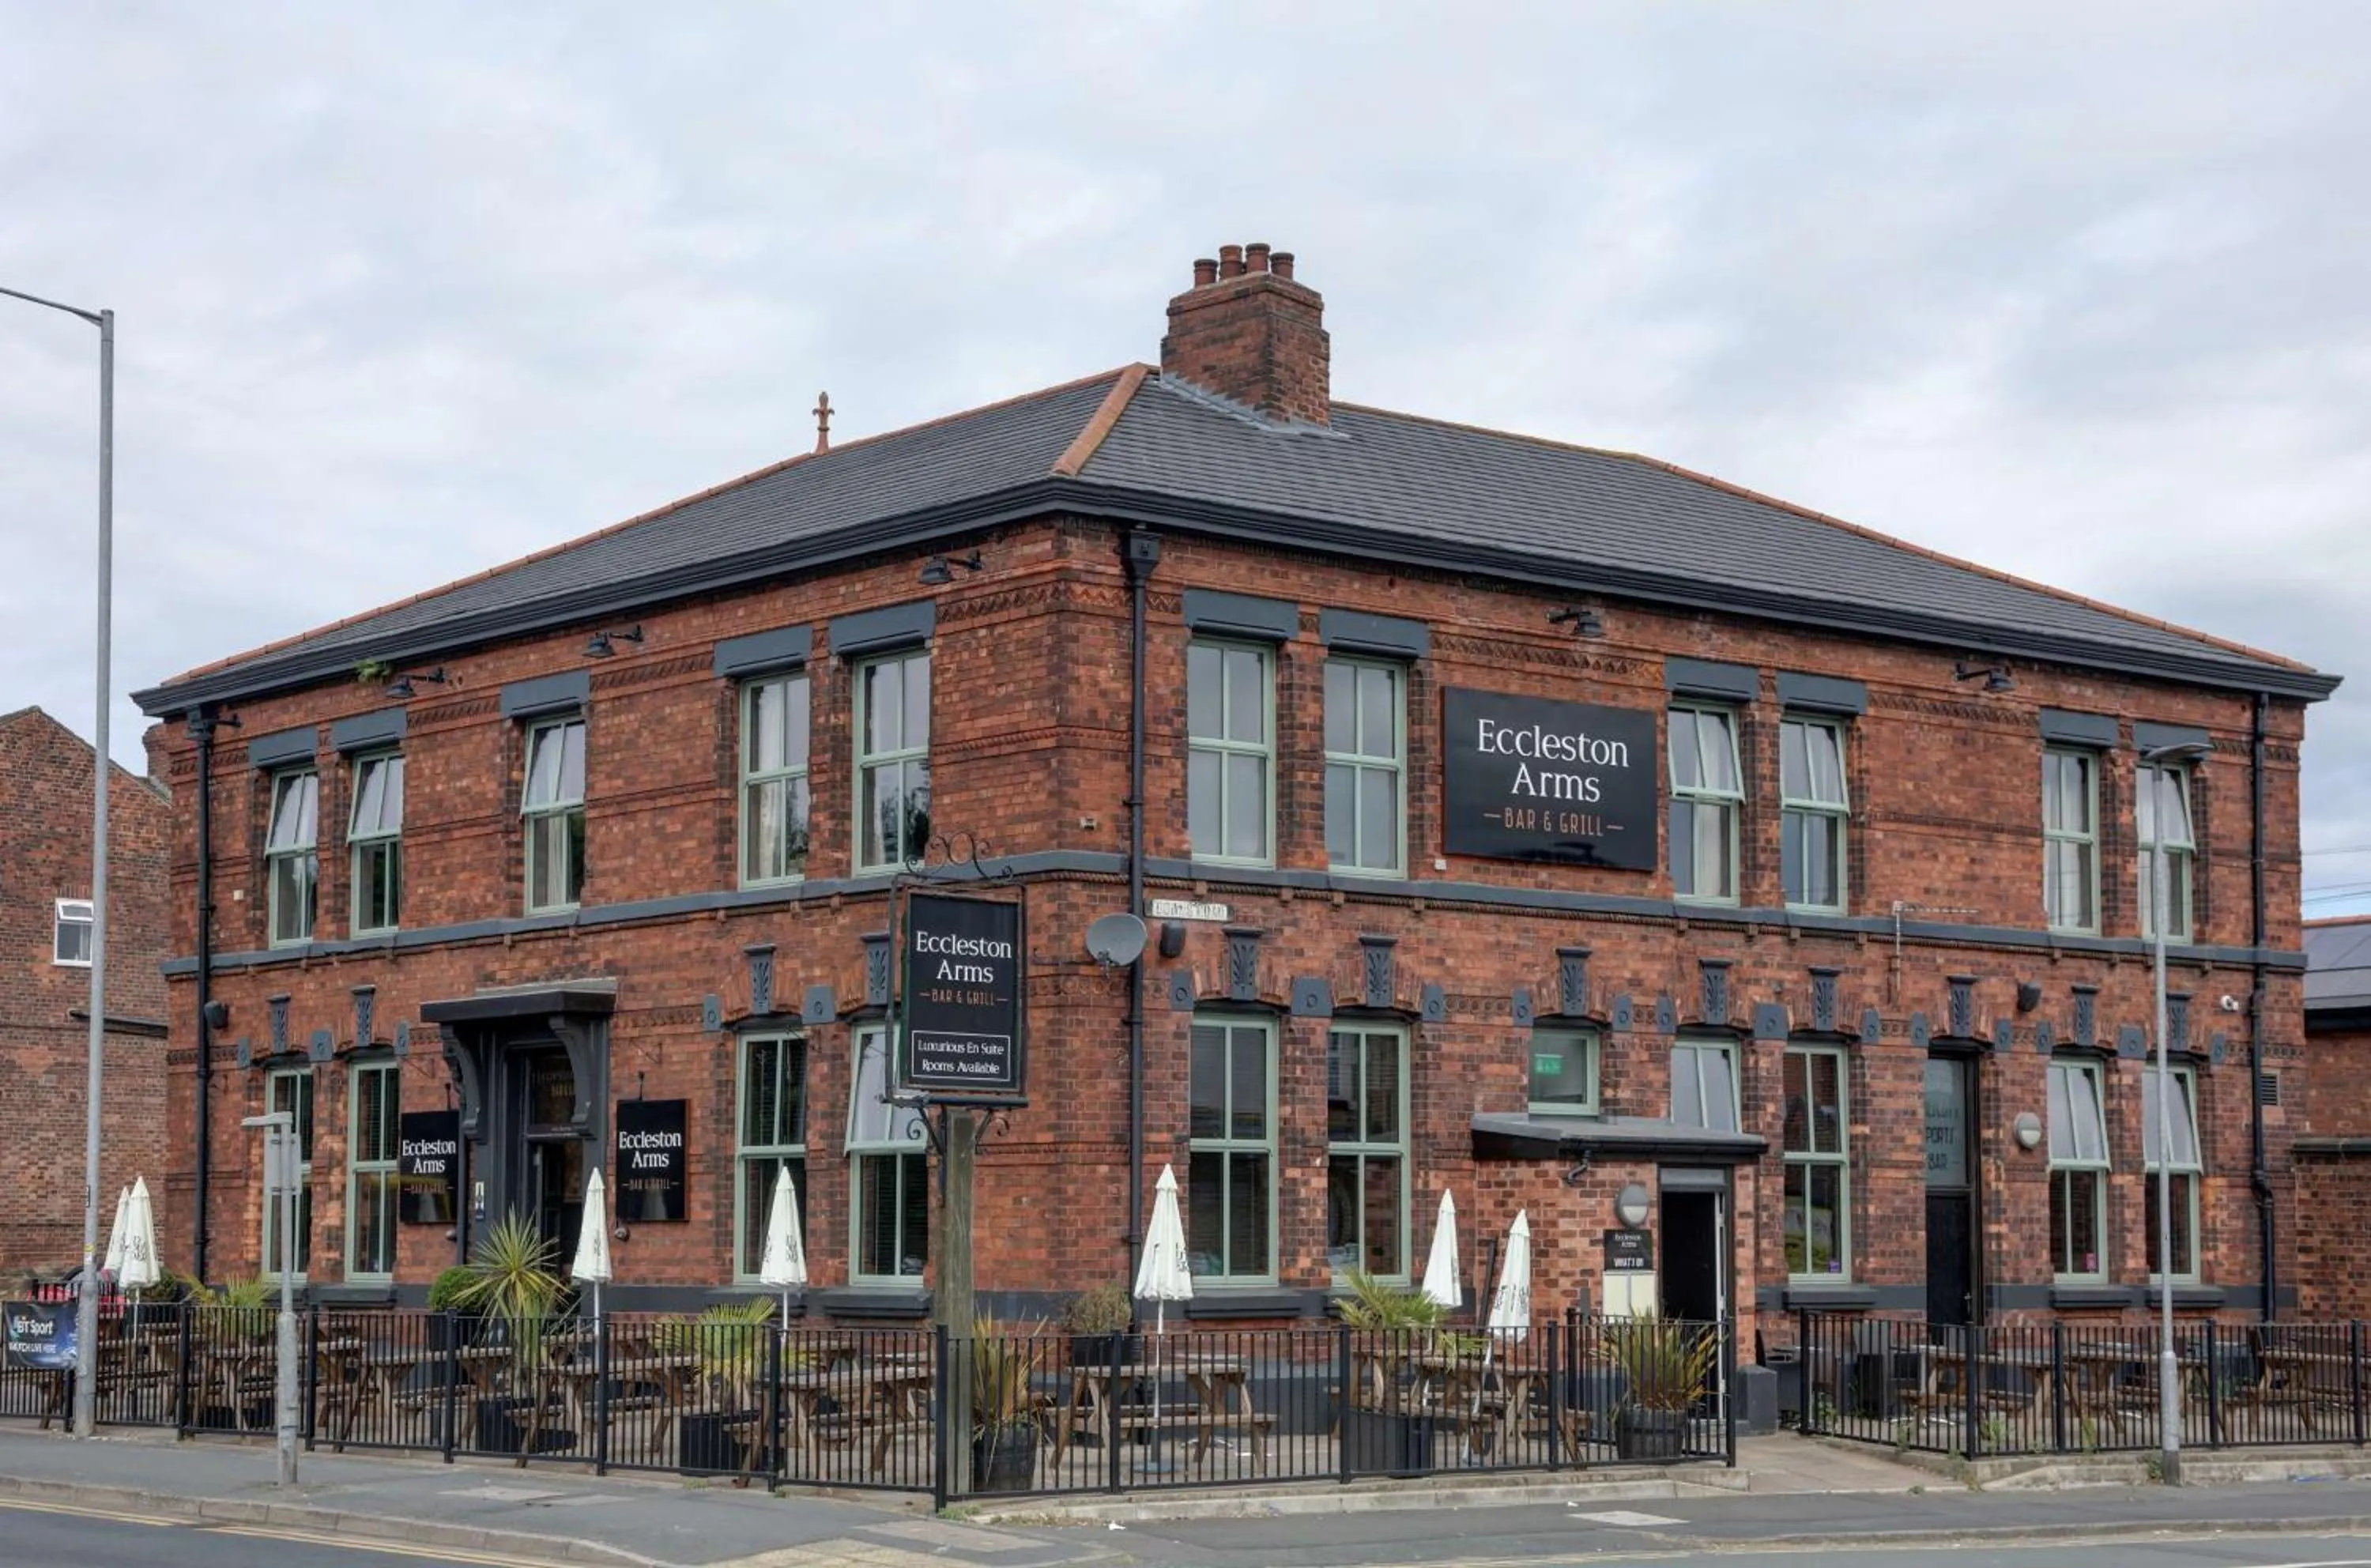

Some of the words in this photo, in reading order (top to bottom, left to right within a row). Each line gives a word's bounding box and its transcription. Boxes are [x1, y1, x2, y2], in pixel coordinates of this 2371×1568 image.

[1477, 718, 1630, 767] Eccleston
[1511, 762, 1601, 803] Arms
[1504, 807, 1536, 829] BAR
[1544, 811, 1552, 831] &
[1559, 812, 1604, 836] GRILL
[915, 930, 1012, 959] Eccleston
[936, 959, 994, 983] Arms
[932, 989, 952, 1004] BAR
[967, 991, 995, 1006] GRILL
[918, 1039, 965, 1054] Luxurious
[967, 1042, 979, 1054] En
[981, 1042, 1005, 1055] Suite
[922, 1058, 954, 1072] Rooms
[957, 1061, 1000, 1075] Available
[402, 1139, 456, 1156] Eccleston
[619, 1131, 682, 1149] Eccleston
[413, 1157, 446, 1174] Arms
[631, 1151, 670, 1169] Arms
[30, 1319, 53, 1338] Sport
